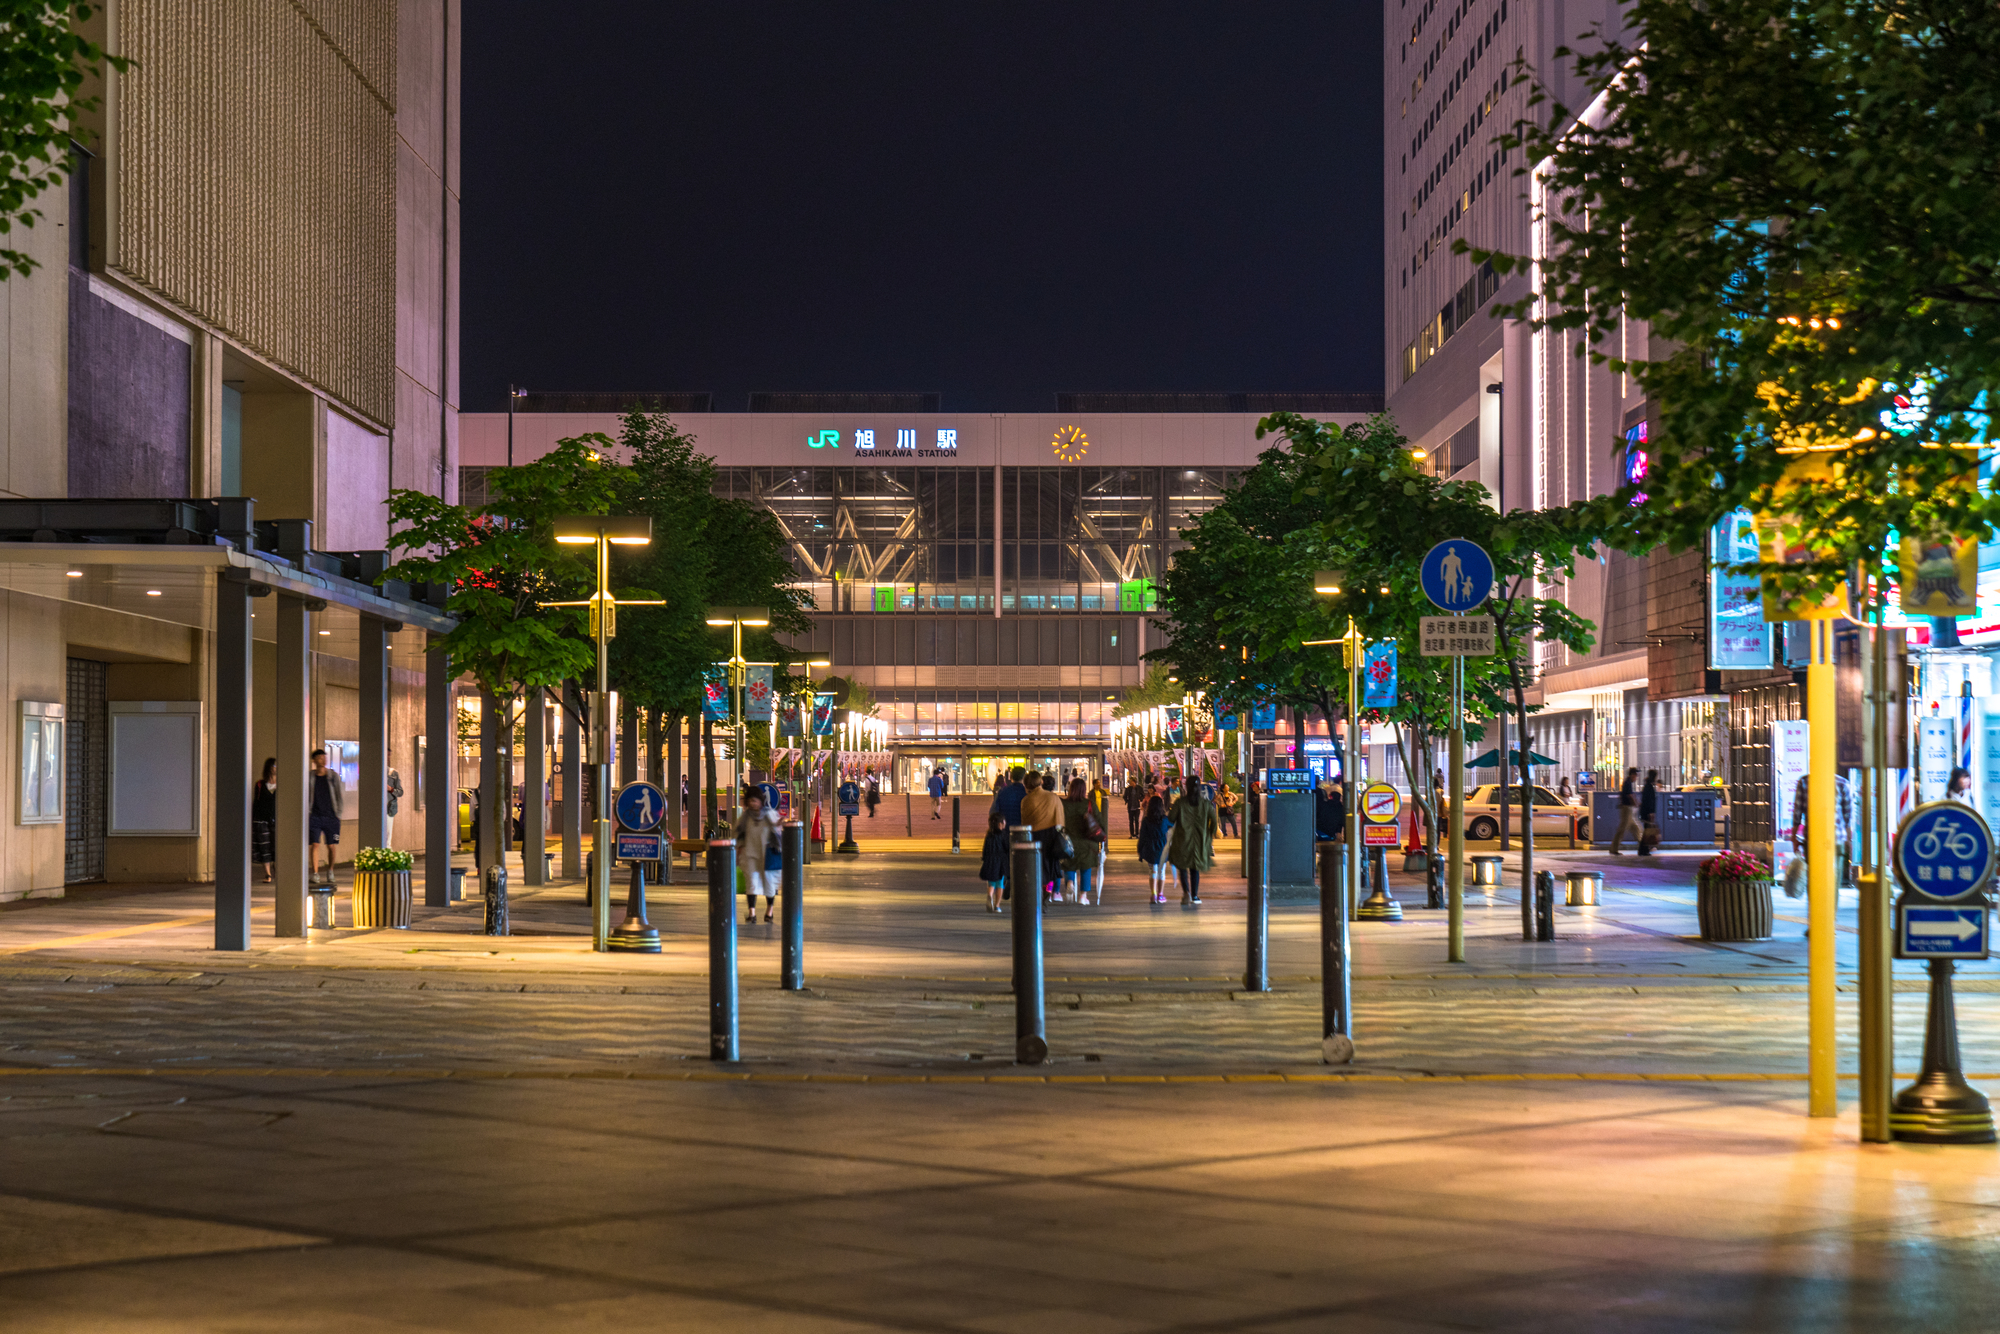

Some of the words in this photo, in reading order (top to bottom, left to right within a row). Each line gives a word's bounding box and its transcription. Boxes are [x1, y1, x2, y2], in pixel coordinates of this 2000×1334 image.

[807, 429, 841, 449] JR
[854, 429, 957, 449] 旭川駅
[855, 449, 912, 458] ASAHIKAWA
[918, 449, 957, 458] STATION
[1426, 621, 1489, 635] 歩行者用道路
[1917, 865, 1974, 881] 駐輪場
